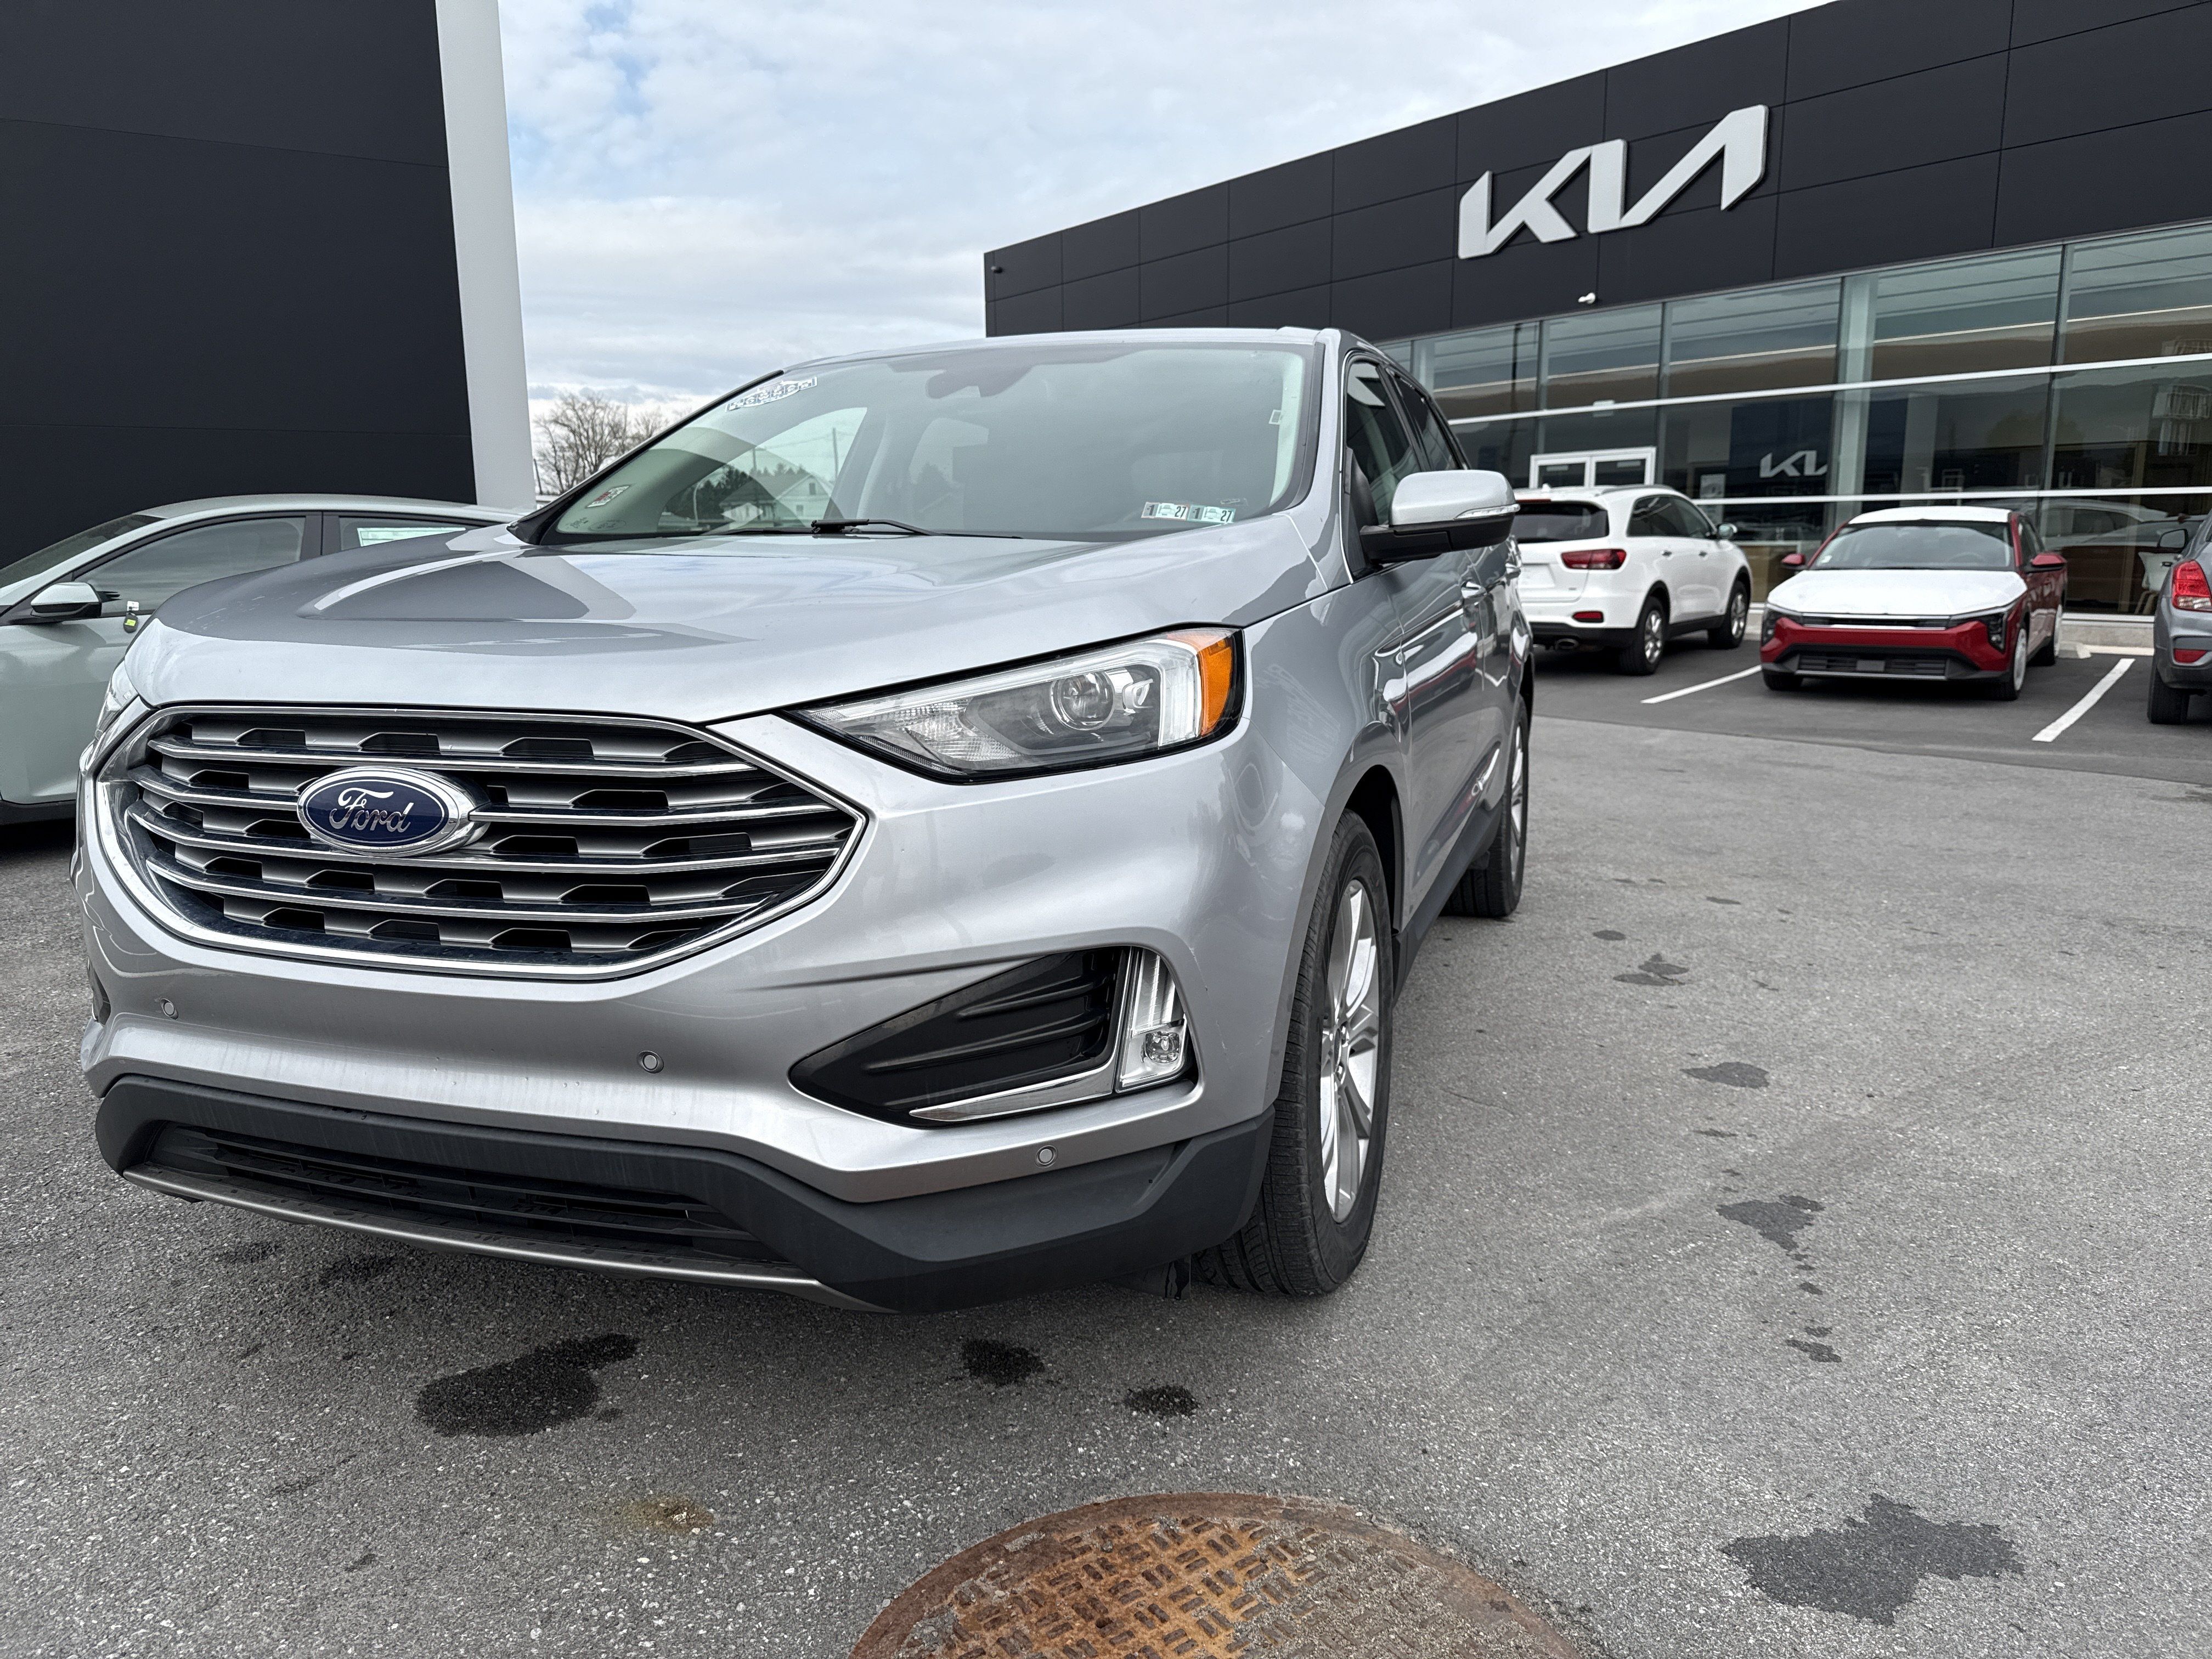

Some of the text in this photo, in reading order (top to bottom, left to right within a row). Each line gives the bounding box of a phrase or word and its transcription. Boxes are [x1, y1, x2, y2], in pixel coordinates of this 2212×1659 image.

[1458, 104, 1769, 259] KIA
[1759, 450, 1827, 478] KI
[1175, 506, 1187, 518] 27
[1220, 510, 1232, 522] 27
[329, 787, 414, 833] Ford
